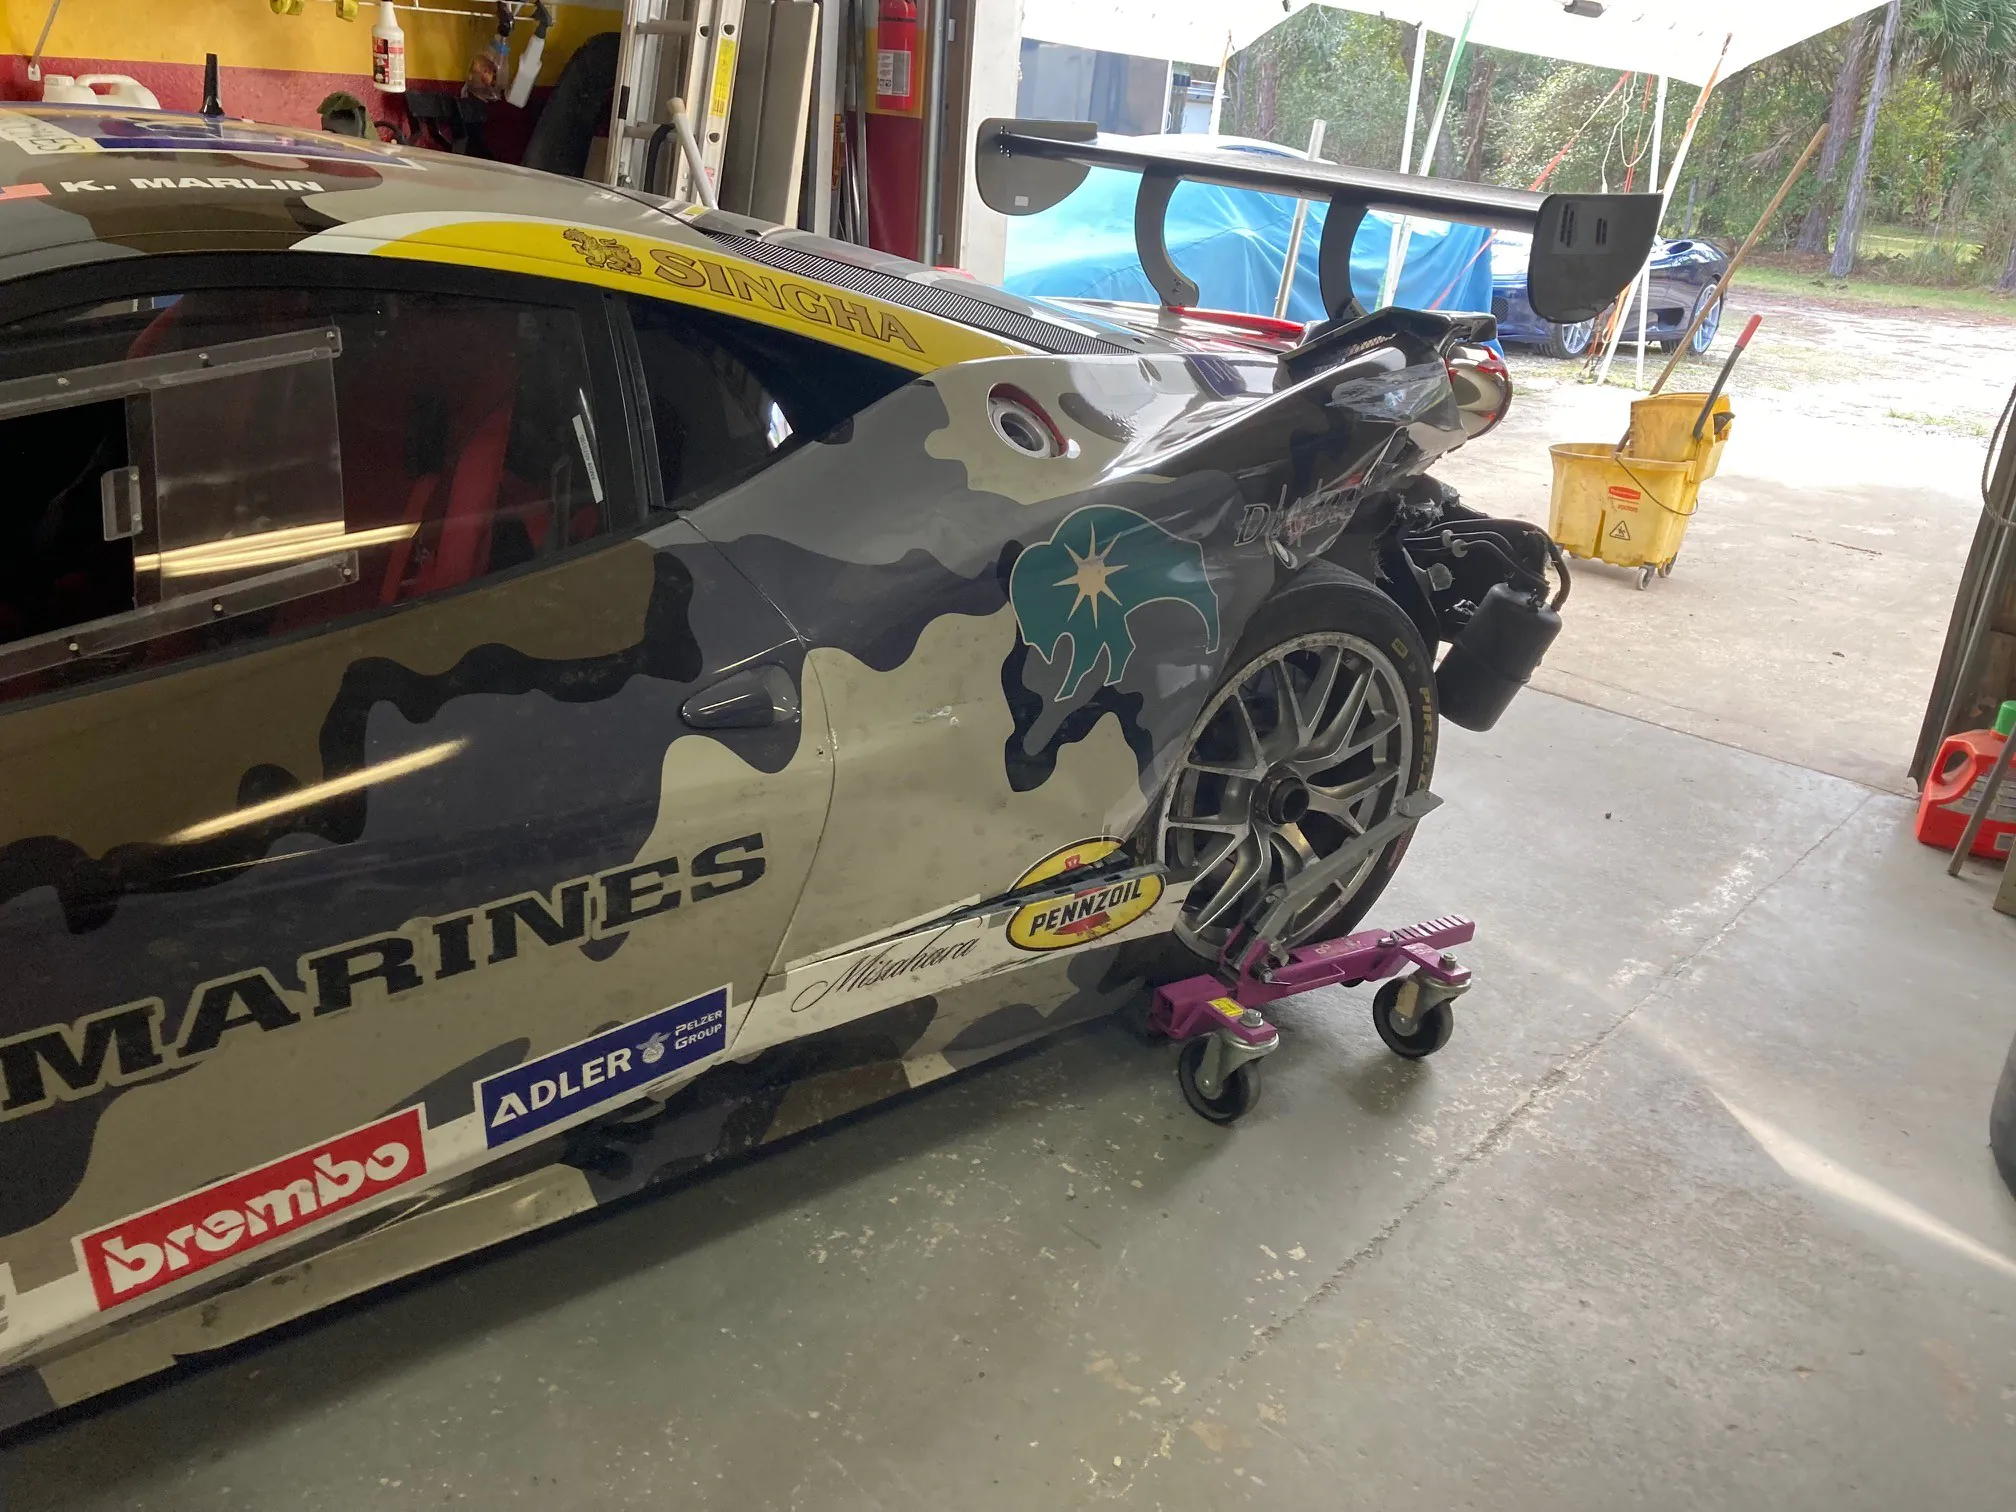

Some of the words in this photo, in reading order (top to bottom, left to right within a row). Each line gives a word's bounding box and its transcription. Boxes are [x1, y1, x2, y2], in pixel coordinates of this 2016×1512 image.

[60, 179, 117, 193] K.
[129, 177, 325, 192] MARLIN
[649, 248, 925, 354] SINGHA
[1419, 686, 1433, 791] PIRELL
[1029, 878, 1142, 938] PENNZOIL
[0, 832, 766, 1109] MARINES
[790, 922, 981, 1013] Misahara
[674, 1009, 723, 1037] PELZER
[674, 1022, 723, 1051] GROUP
[490, 1047, 633, 1129] ADLER
[102, 1142, 410, 1295] brembo
